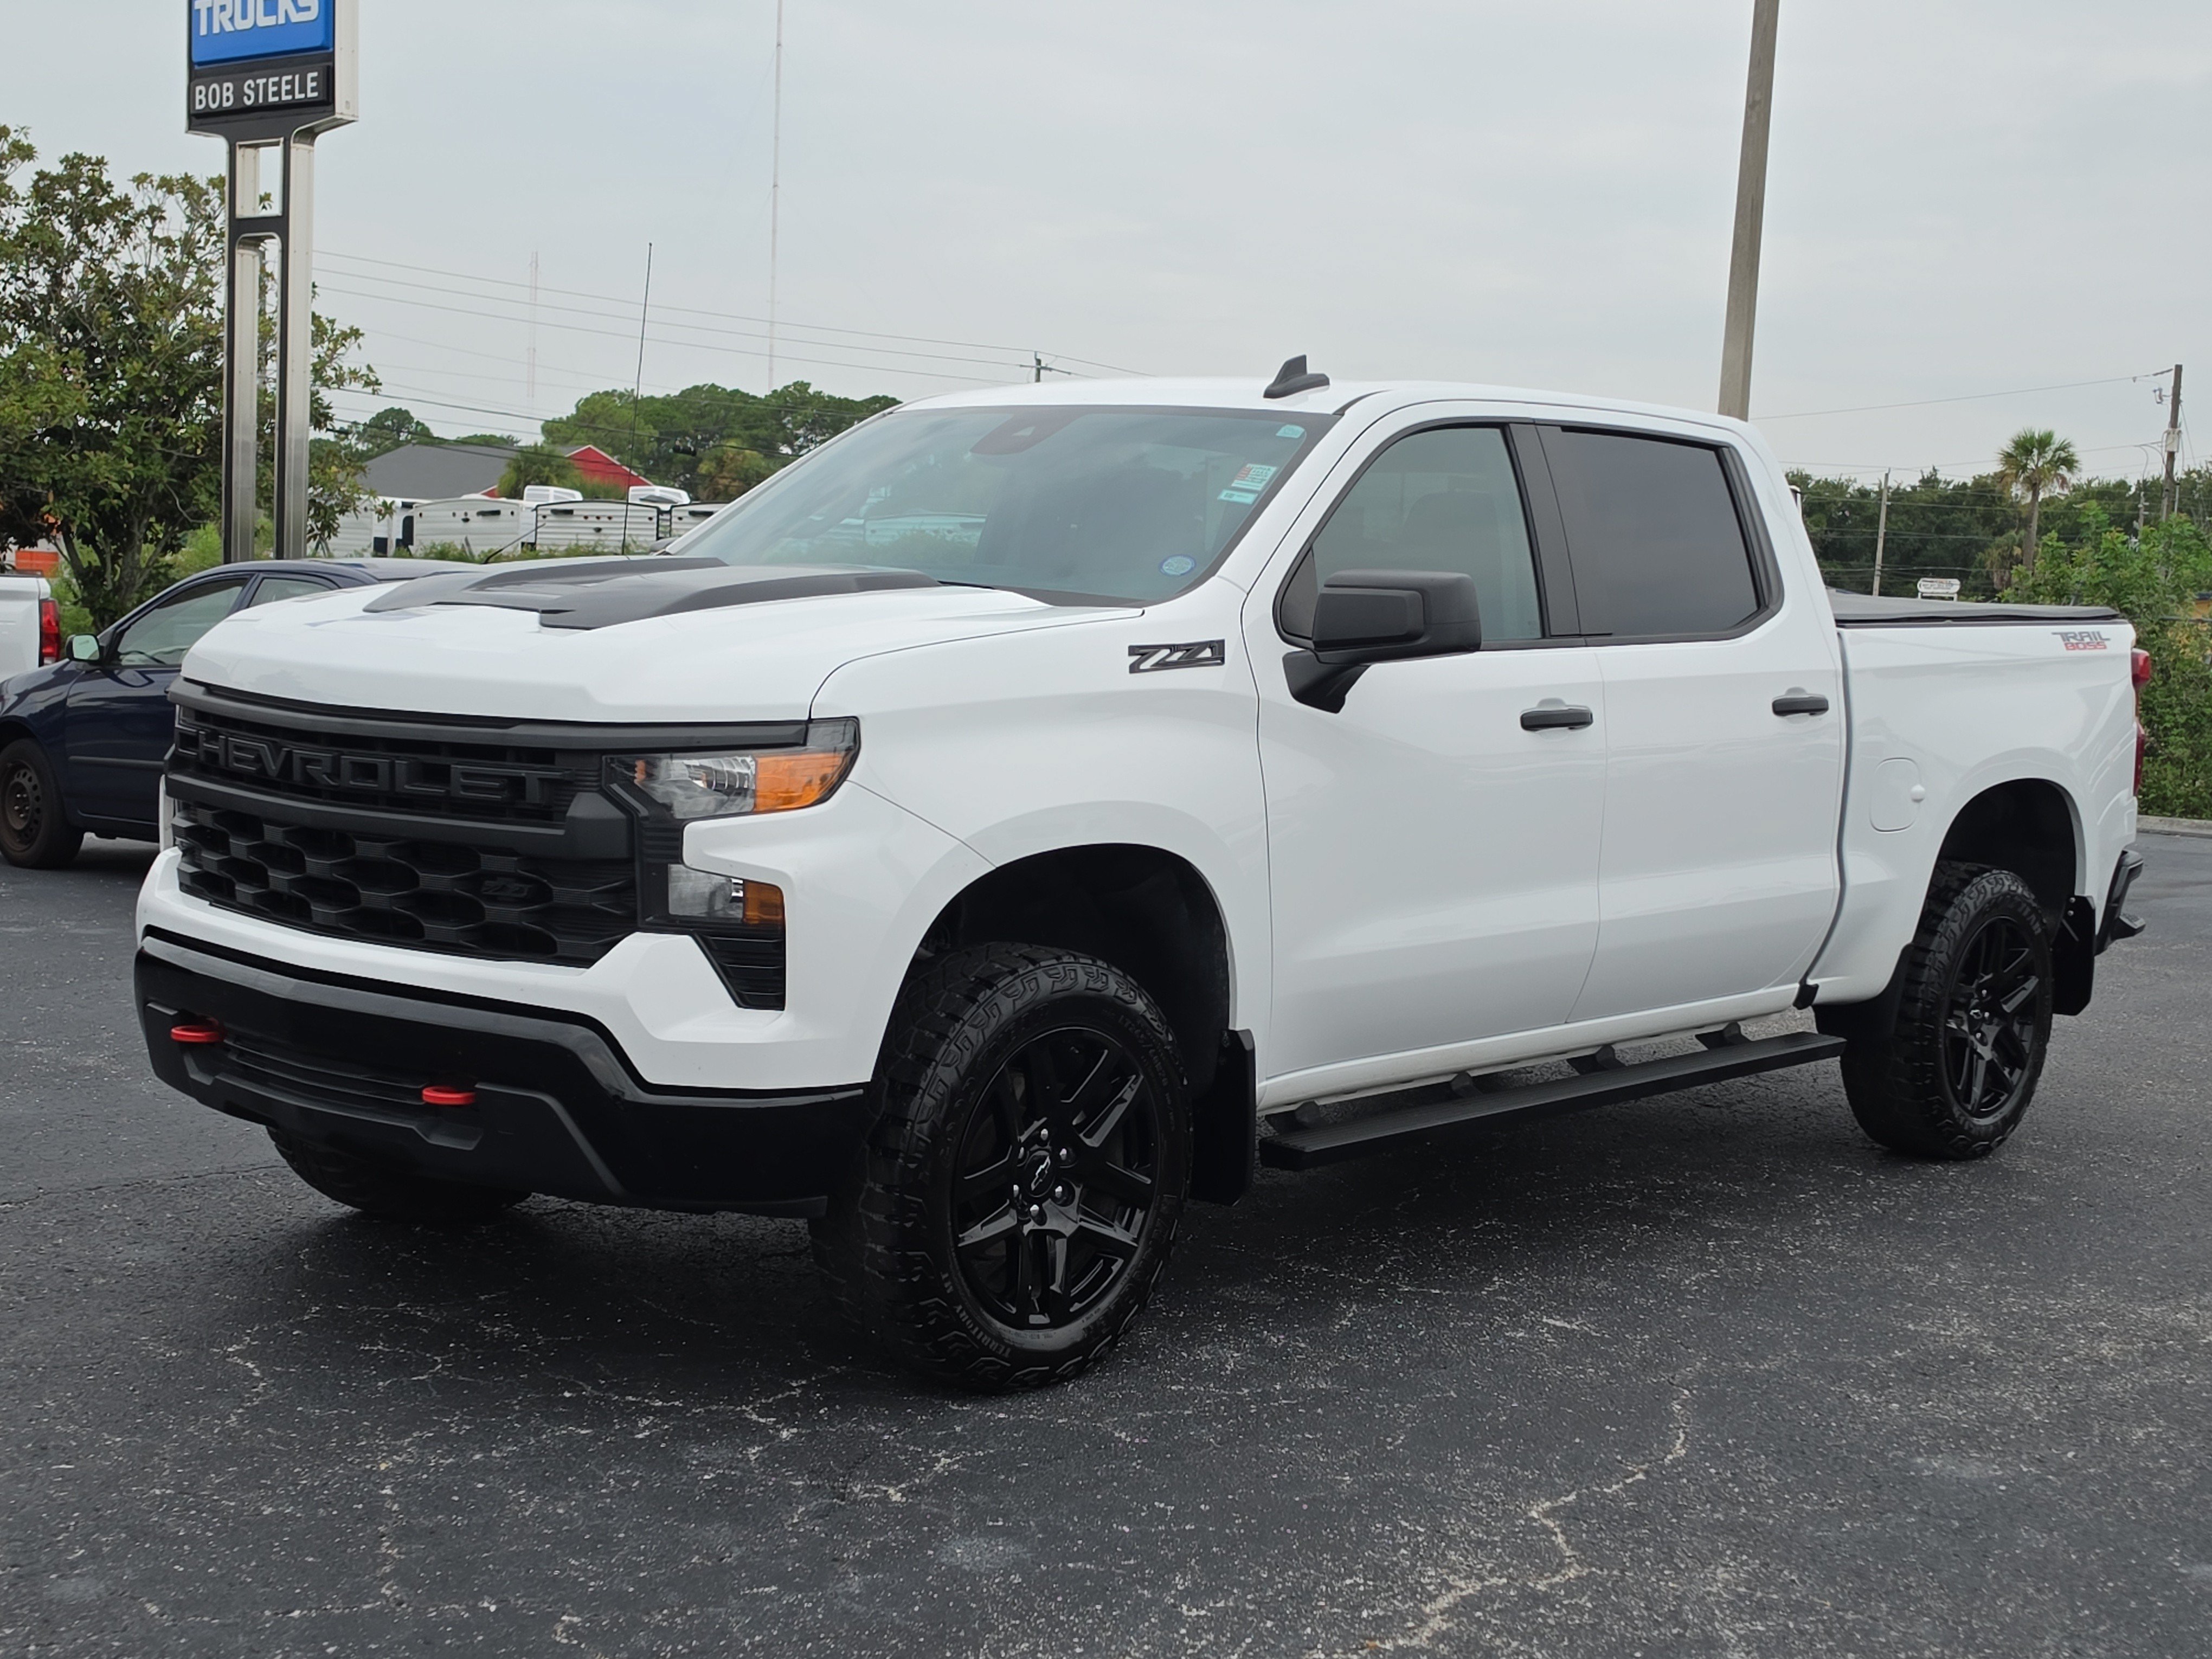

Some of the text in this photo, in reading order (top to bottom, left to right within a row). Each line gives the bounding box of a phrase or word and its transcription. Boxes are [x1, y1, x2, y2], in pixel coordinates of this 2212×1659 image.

[194, 0, 319, 36] TRUCKS
[195, 72, 319, 110] BOB STEELE
[2052, 631, 2111, 642] TRAIL
[2064, 641, 2107, 651] BOSS
[177, 727, 575, 805] CHEVROLET
[953, 1304, 1012, 1358] TERRITORY
